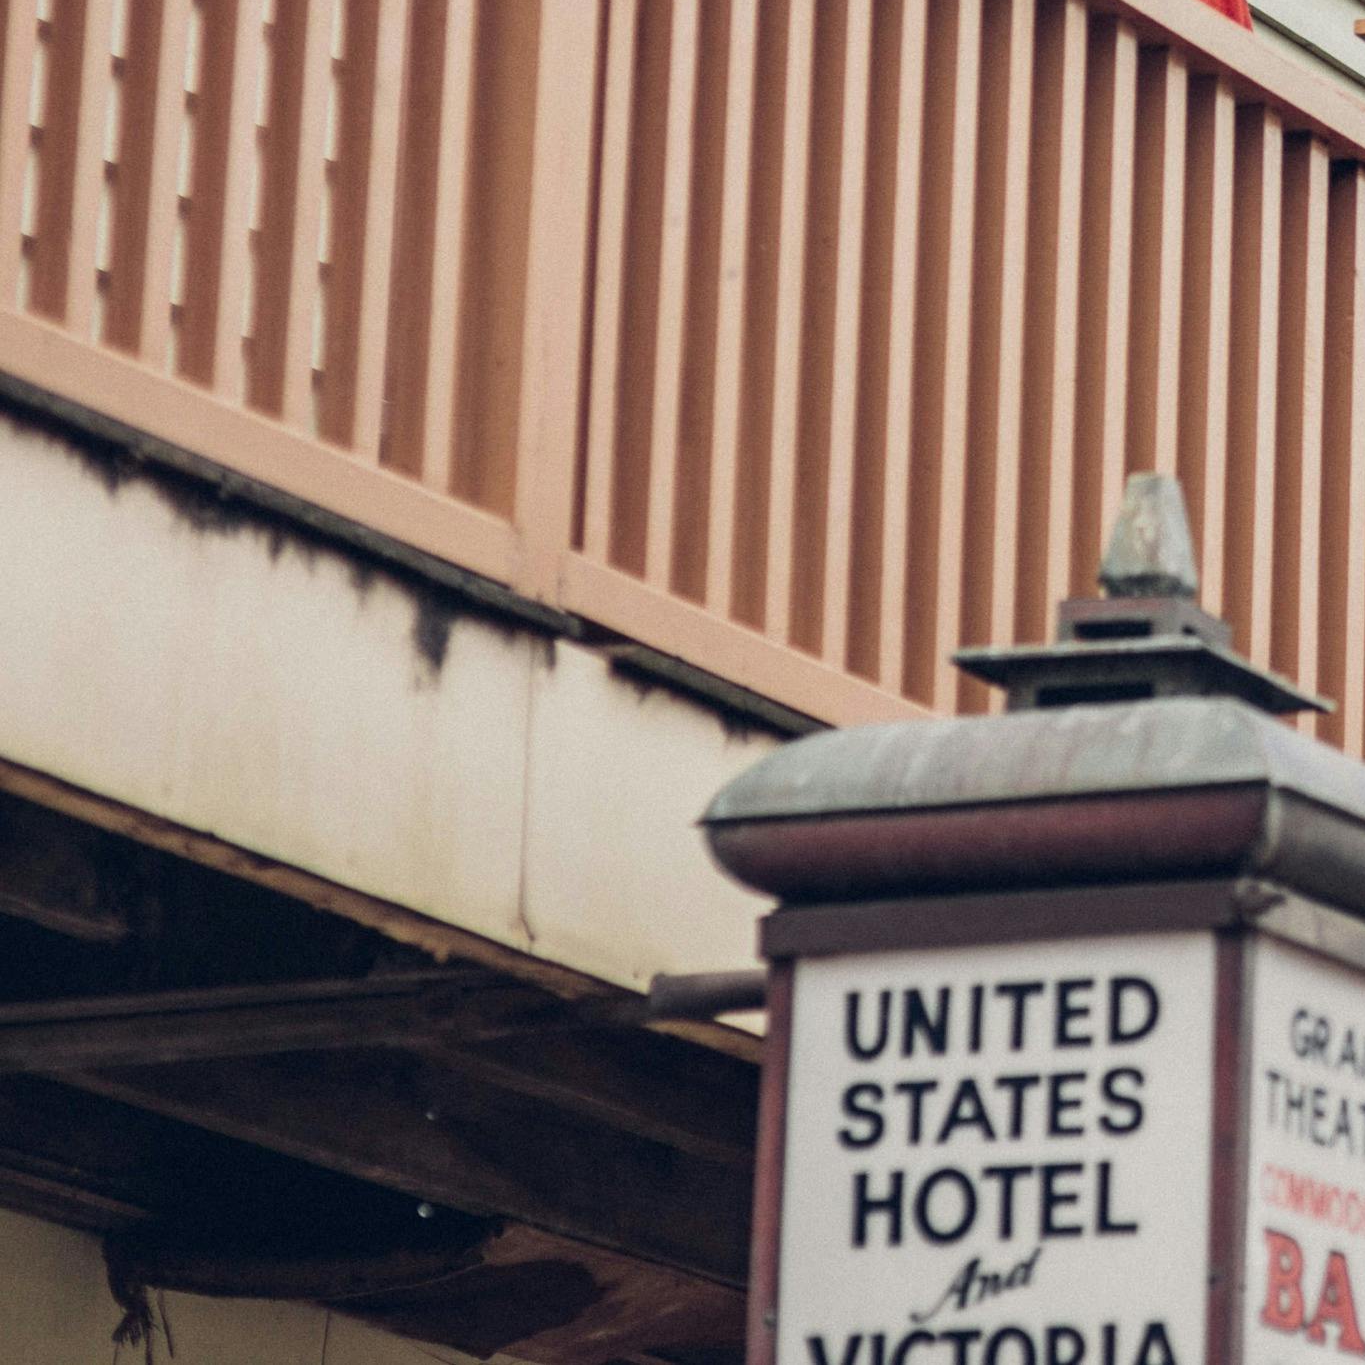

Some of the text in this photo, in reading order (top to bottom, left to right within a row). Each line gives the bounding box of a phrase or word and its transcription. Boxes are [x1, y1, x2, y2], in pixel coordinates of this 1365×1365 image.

[845, 976, 1160, 1063] UNITED
[836, 1066, 1146, 1151] STATES
[851, 1160, 1139, 1250] HOTEL
[909, 1246, 1042, 1325] And
